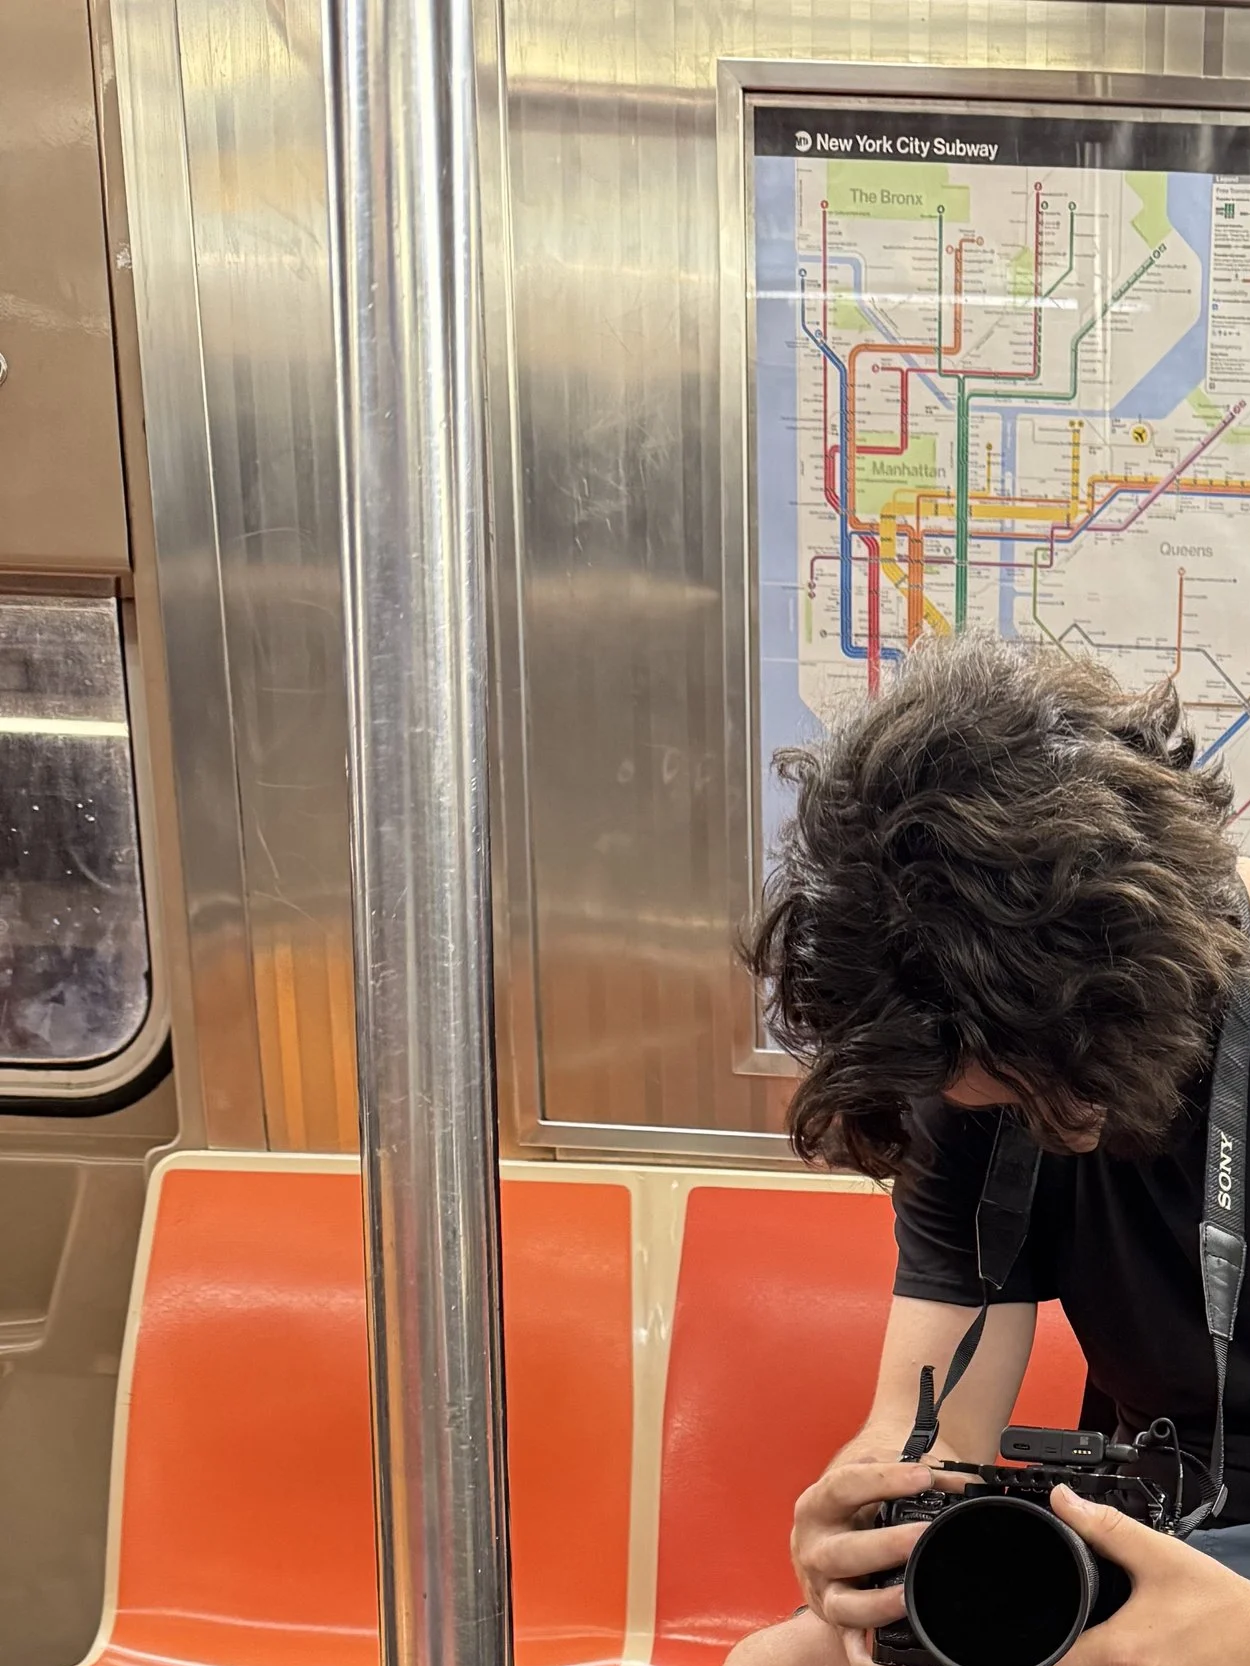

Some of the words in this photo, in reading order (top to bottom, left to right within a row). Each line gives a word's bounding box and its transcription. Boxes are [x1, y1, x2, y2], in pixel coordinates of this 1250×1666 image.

[816, 133, 852, 151] New
[856, 134, 893, 154] York
[896, 136, 930, 158] City
[933, 137, 999, 161] Subway
[850, 188, 877, 204] The
[881, 189, 923, 206] Bronx
[872, 461, 946, 478] Manhattan
[1160, 542, 1213, 558] Queens
[1217, 1131, 1233, 1210] SONY
